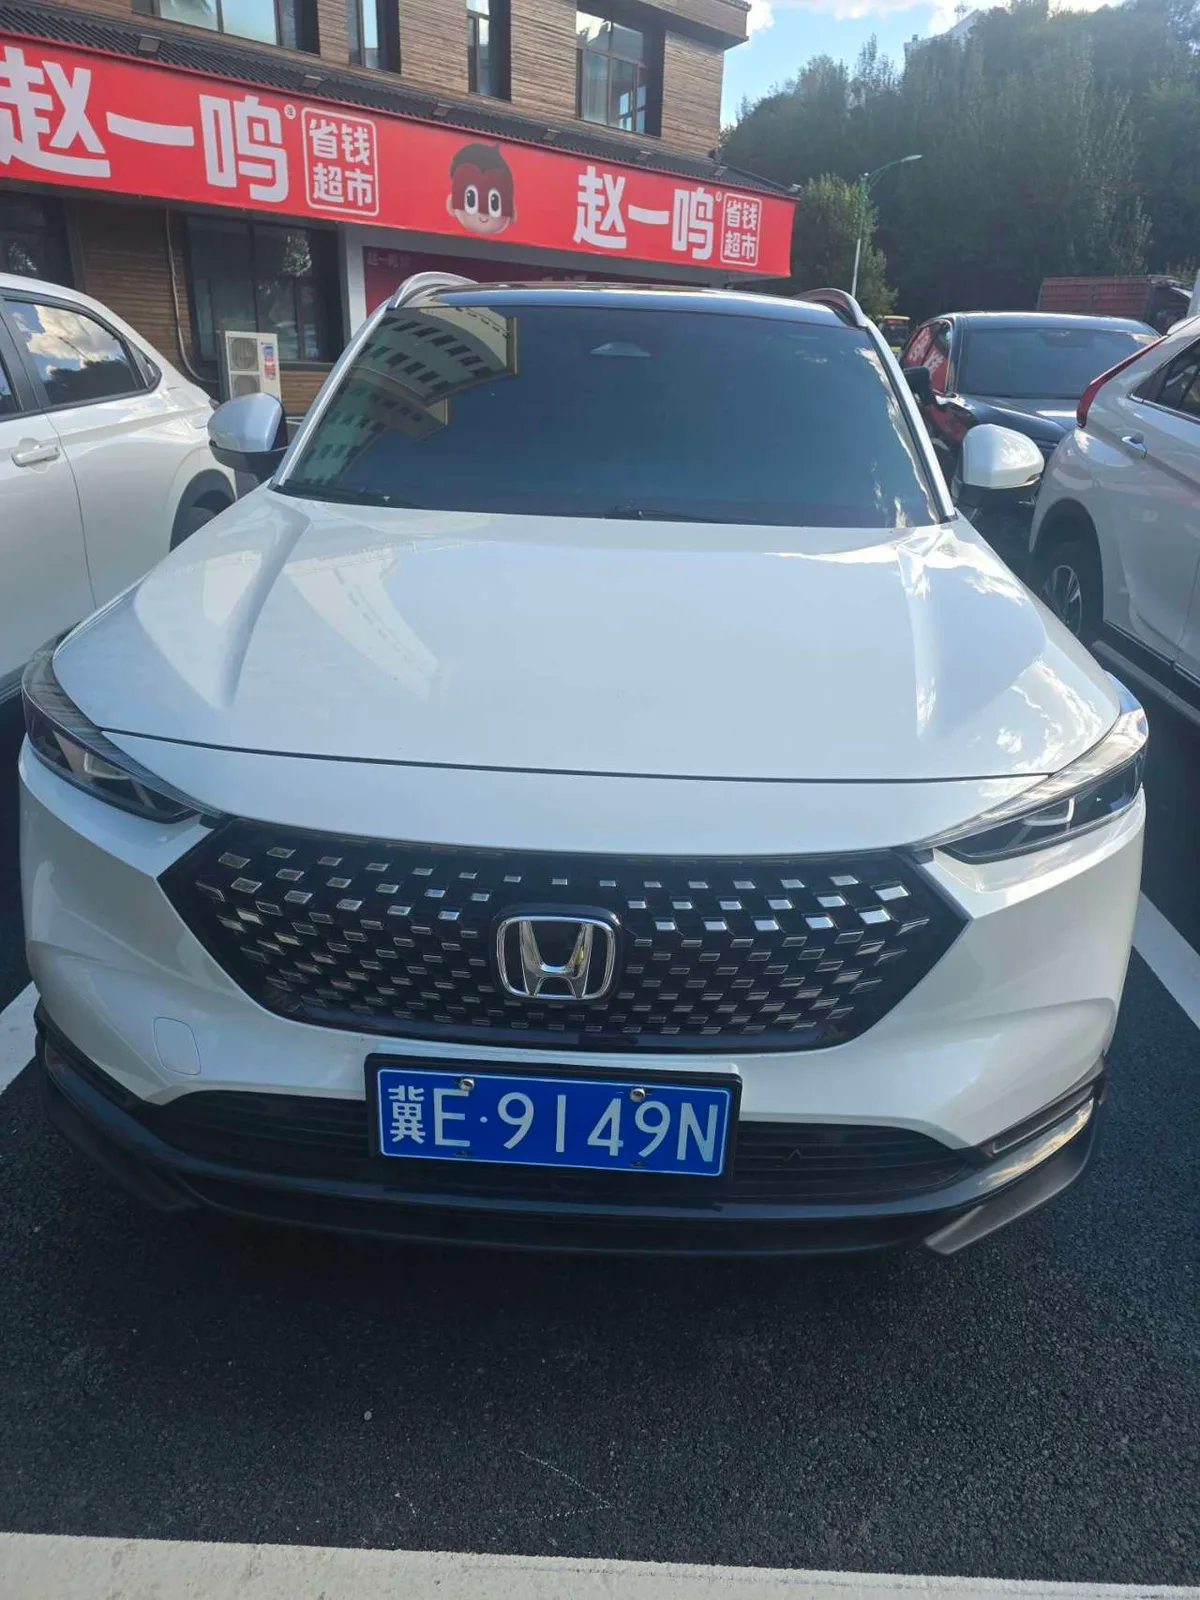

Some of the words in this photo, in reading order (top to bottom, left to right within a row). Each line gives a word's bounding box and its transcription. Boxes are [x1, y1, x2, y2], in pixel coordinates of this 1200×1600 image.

[0, 46, 288, 202] 赵一鸣
[309, 118, 370, 166] 省钱
[313, 162, 374, 206] 超市
[573, 165, 714, 260] 赵一鸣
[726, 200, 757, 231] 省钱
[723, 230, 757, 260] 超市
[388, 1085, 718, 1163] 冀E·9149N
